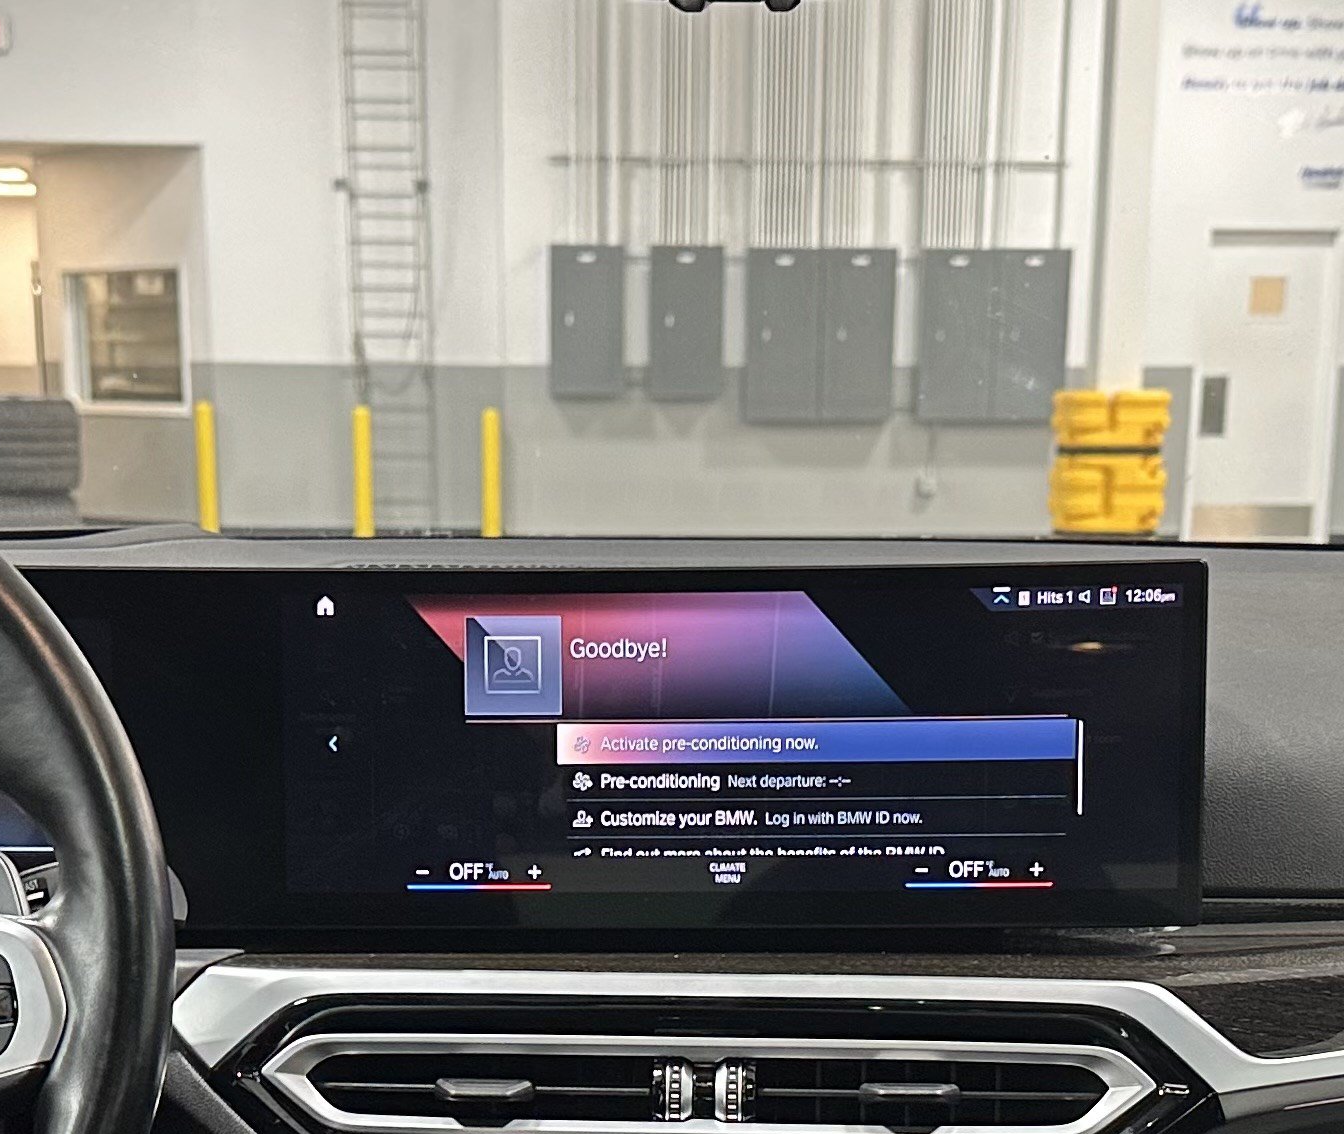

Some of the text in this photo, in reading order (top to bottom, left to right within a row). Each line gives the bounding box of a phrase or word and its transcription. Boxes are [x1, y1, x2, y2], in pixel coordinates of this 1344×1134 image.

[1037, 590, 1073, 605] Hits 1
[570, 638, 667, 663] Goodbye!
[600, 735, 819, 754] Activate pre-conditioning now.
[600, 773, 721, 792] Pre-conditioning
[727, 775, 757, 788] Next
[759, 775, 827, 791] departure:
[600, 810, 923, 829] Customize your BMW. Log in with BMW ID now.
[449, 862, 484, 880] OFF
[709, 862, 746, 873] CLIMATE
[948, 860, 984, 878] OFF
[714, 873, 742, 884] MENU
